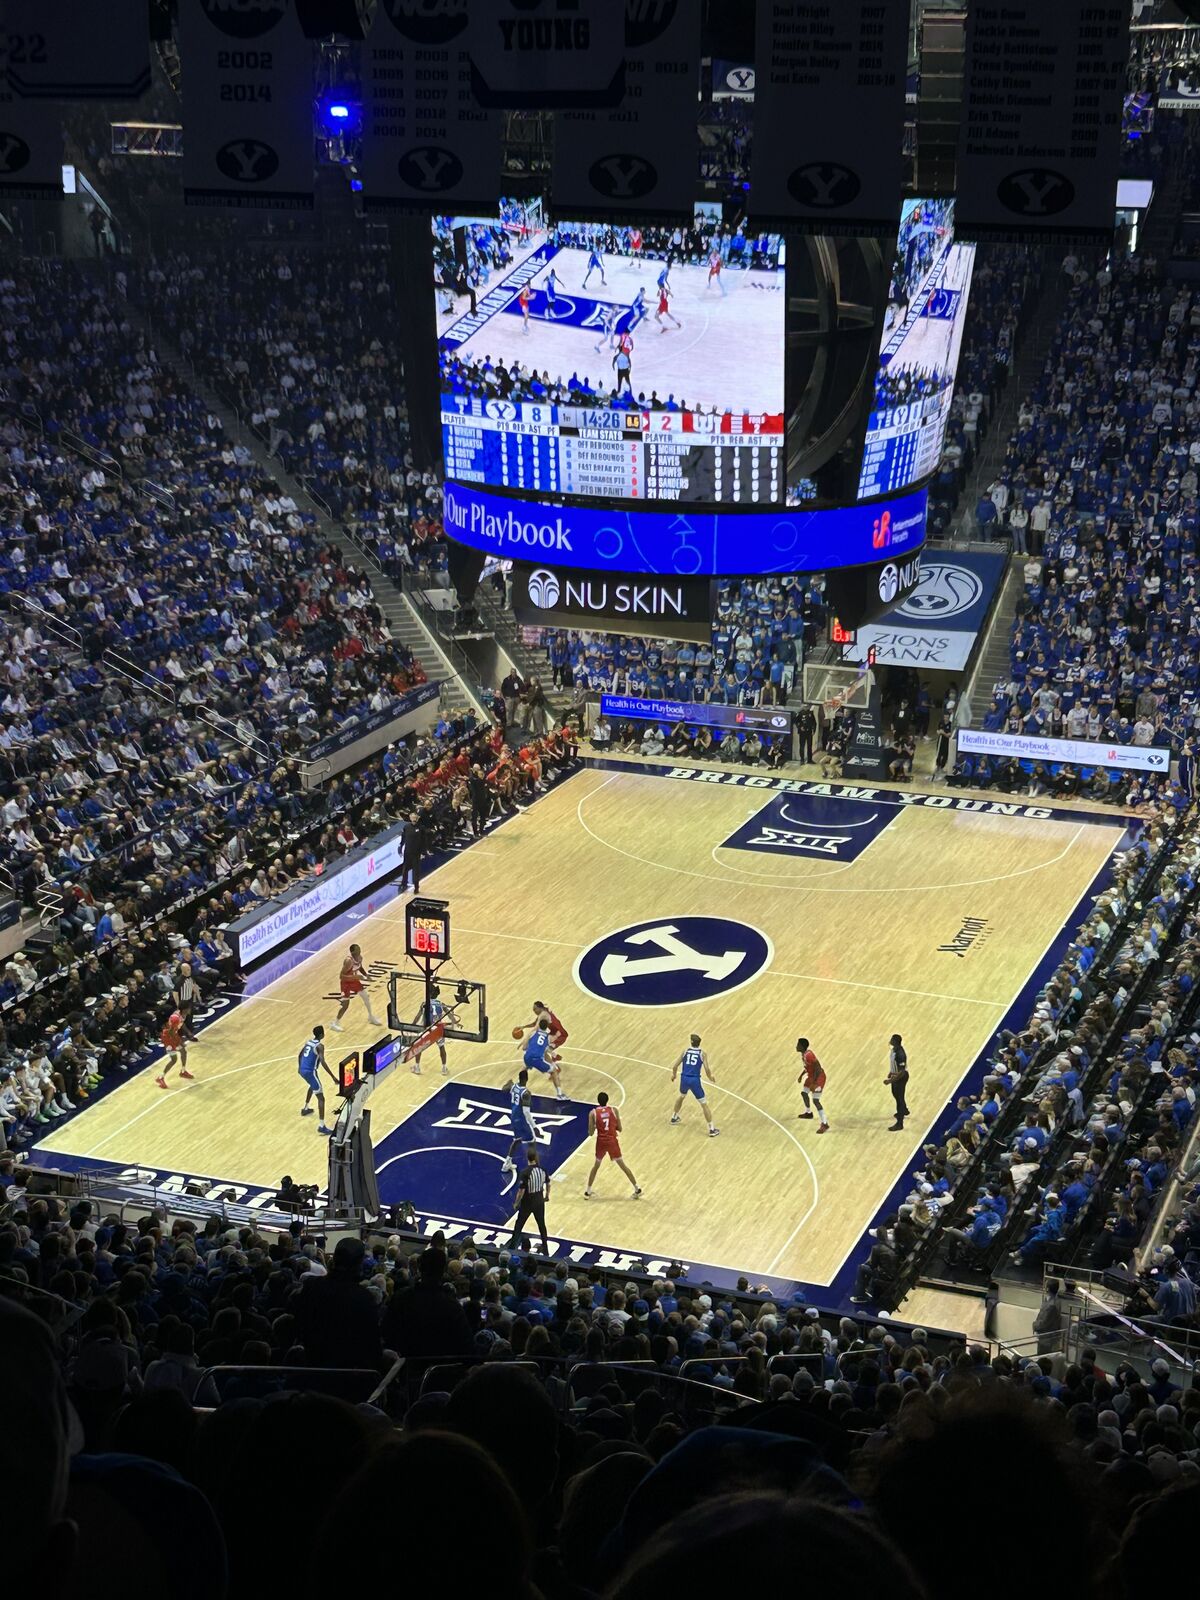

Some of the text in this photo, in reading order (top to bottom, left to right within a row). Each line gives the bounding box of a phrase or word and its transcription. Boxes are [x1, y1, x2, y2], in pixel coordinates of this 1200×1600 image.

[498, 18, 591, 50] YOUNG
[217, 51, 273, 70] 2002
[220, 85, 272, 101] 2014
[443, 415, 465, 425] PLAYER
[529, 424, 541, 434] AST
[547, 426, 555, 434] PF
[532, 407, 541, 422] 8
[582, 411, 620, 428] 14:26
[661, 416, 671, 431] 2
[578, 428, 623, 440] TEAM STATS
[645, 434, 673, 443] PLAYER
[711, 436, 725, 444] PTS
[748, 436, 762, 445] AST
[769, 436, 779, 445] PF
[650, 455, 656, 465] 7
[631, 466, 637, 474] 2
[647, 488, 656, 498] 21
[448, 494, 573, 551] Our Playbook
[898, 560, 915, 592] NU
[566, 580, 607, 610] NU
[871, 632, 950, 649] ZIONS
[873, 645, 945, 663] BANK
[605, 698, 629, 709] Health
[629, 699, 635, 709] is
[636, 701, 651, 711] Our
[652, 703, 685, 715] Playbook
[962, 734, 988, 746] Health
[989, 736, 996, 746] is
[997, 737, 1013, 748] Our
[1015, 739, 1050, 752] Playbook
[664, 767, 1054, 820] BRIGHAM YOUNG
[240, 924, 267, 951] Health
[267, 921, 274, 933] is
[273, 912, 289, 930] Our
[290, 891, 322, 922] Playbook
[936, 916, 989, 958] Marriott
[599, 924, 747, 987] Y
[537, 1036, 546, 1046] 6
[303, 1046, 311, 1058] 3
[685, 1053, 698, 1066] 15
[603, 1118, 610, 1131] 7
